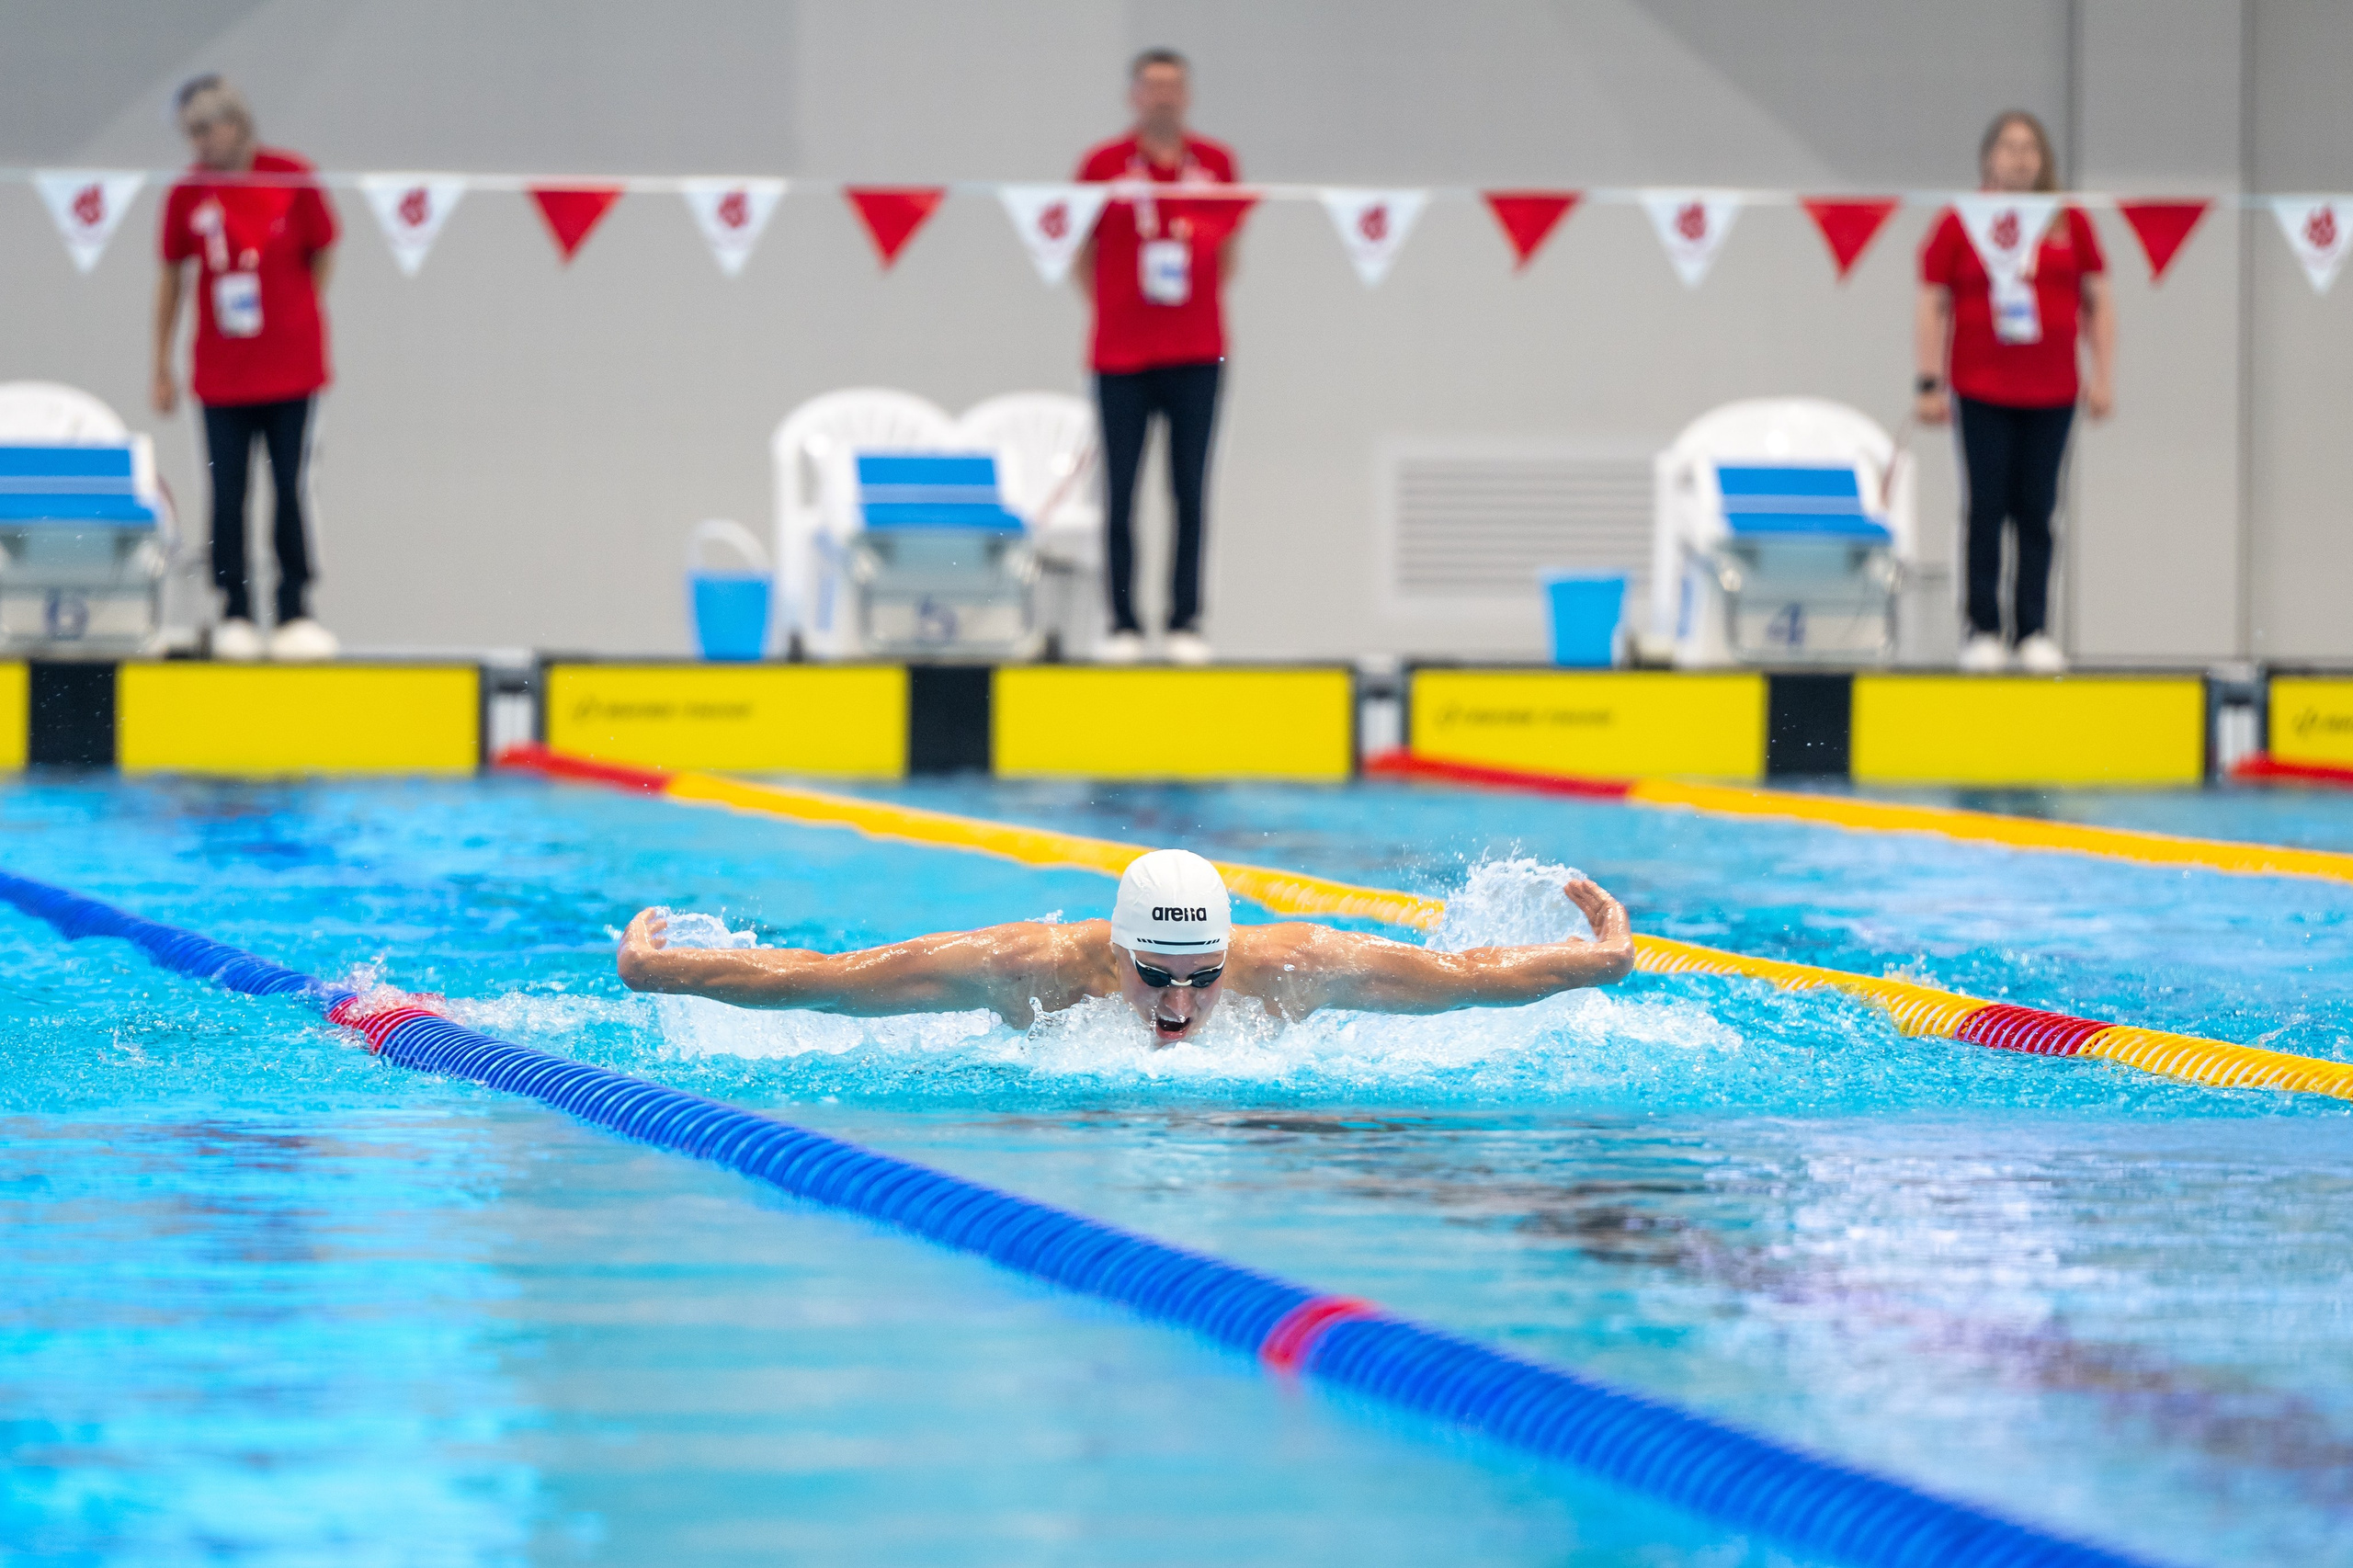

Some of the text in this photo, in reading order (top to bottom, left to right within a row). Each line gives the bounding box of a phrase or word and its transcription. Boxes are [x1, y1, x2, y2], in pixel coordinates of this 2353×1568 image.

[45, 586, 89, 641] 6
[1768, 602, 1805, 647] 4
[1152, 906, 1207, 922] arena
